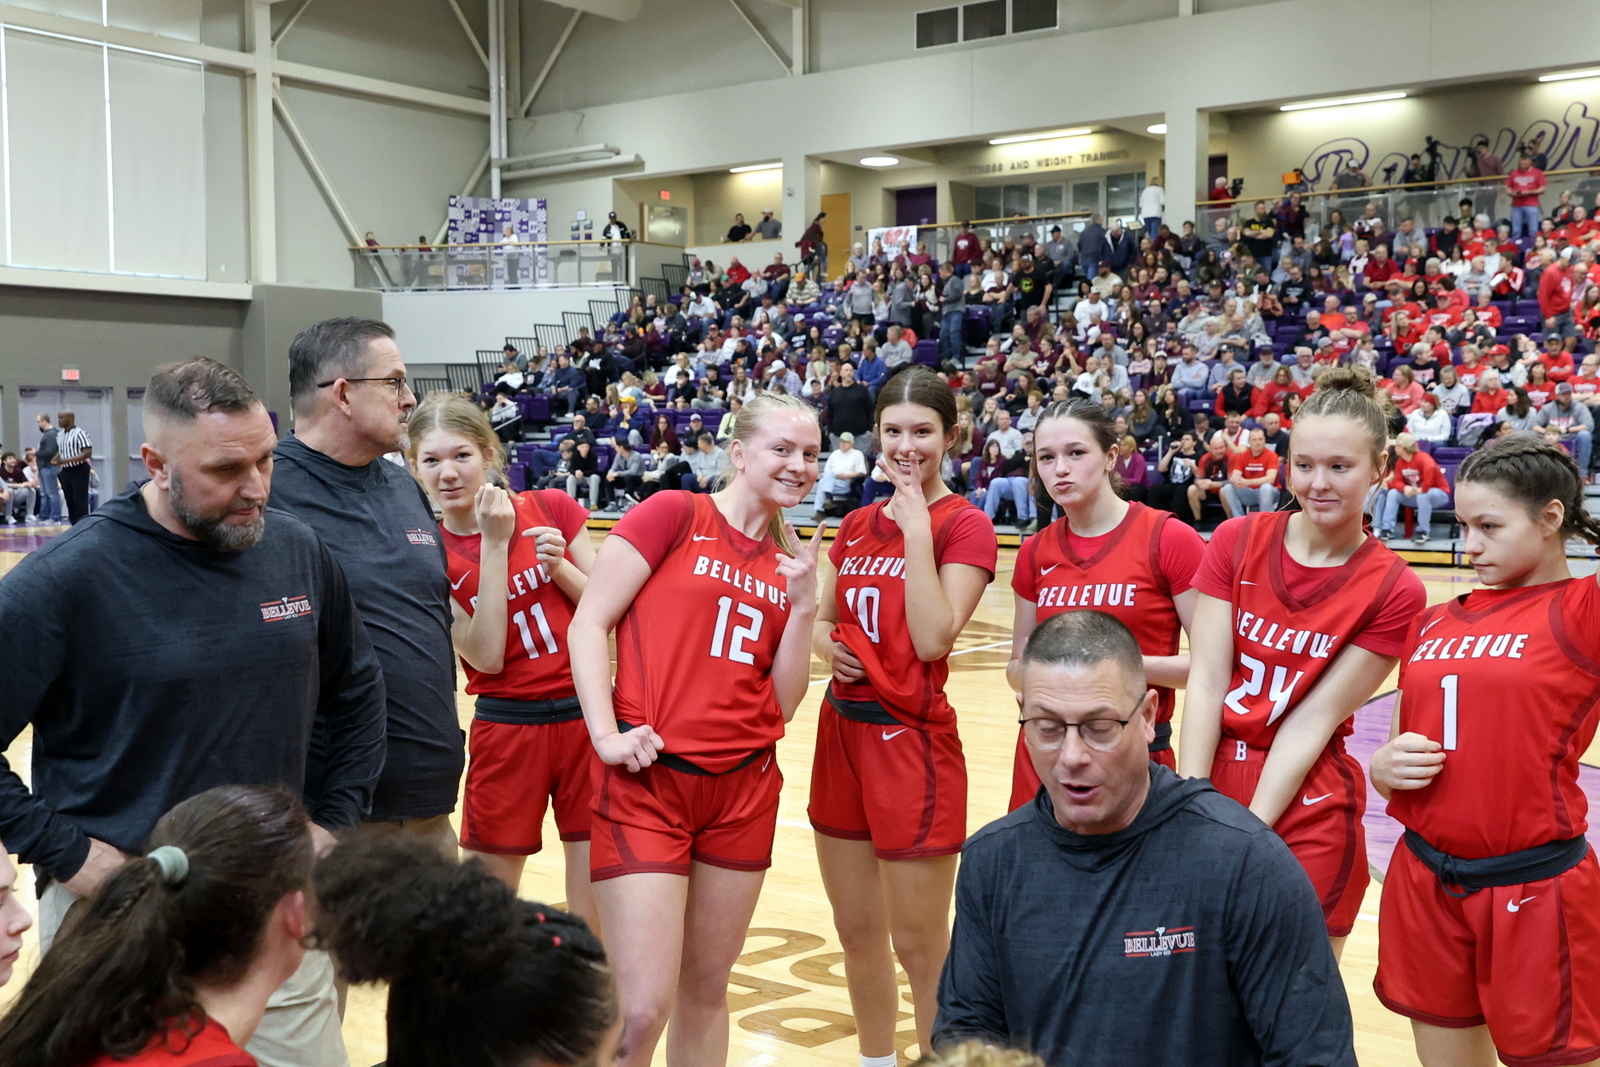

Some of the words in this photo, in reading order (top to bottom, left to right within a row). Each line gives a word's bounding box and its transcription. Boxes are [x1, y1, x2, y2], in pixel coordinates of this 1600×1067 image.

[1010, 160, 1029, 170] AND
[1036, 155, 1073, 168] WEIGHT
[693, 555, 787, 611] BELLEVUE
[838, 556, 905, 579] ELLEVU
[261, 599, 311, 620] BELLEVUE
[845, 586, 880, 643] 10
[1037, 583, 1137, 607] BELLEVUE
[512, 602, 558, 660] 11
[710, 596, 755, 665] 12
[1236, 607, 1339, 658] ELLEVUE
[1408, 633, 1529, 665] ELLEVUE
[1224, 652, 1305, 727] 24
[1440, 674, 1458, 751] 1
[1235, 740, 1247, 761] B
[1124, 932, 1194, 953] BELLEVUE
